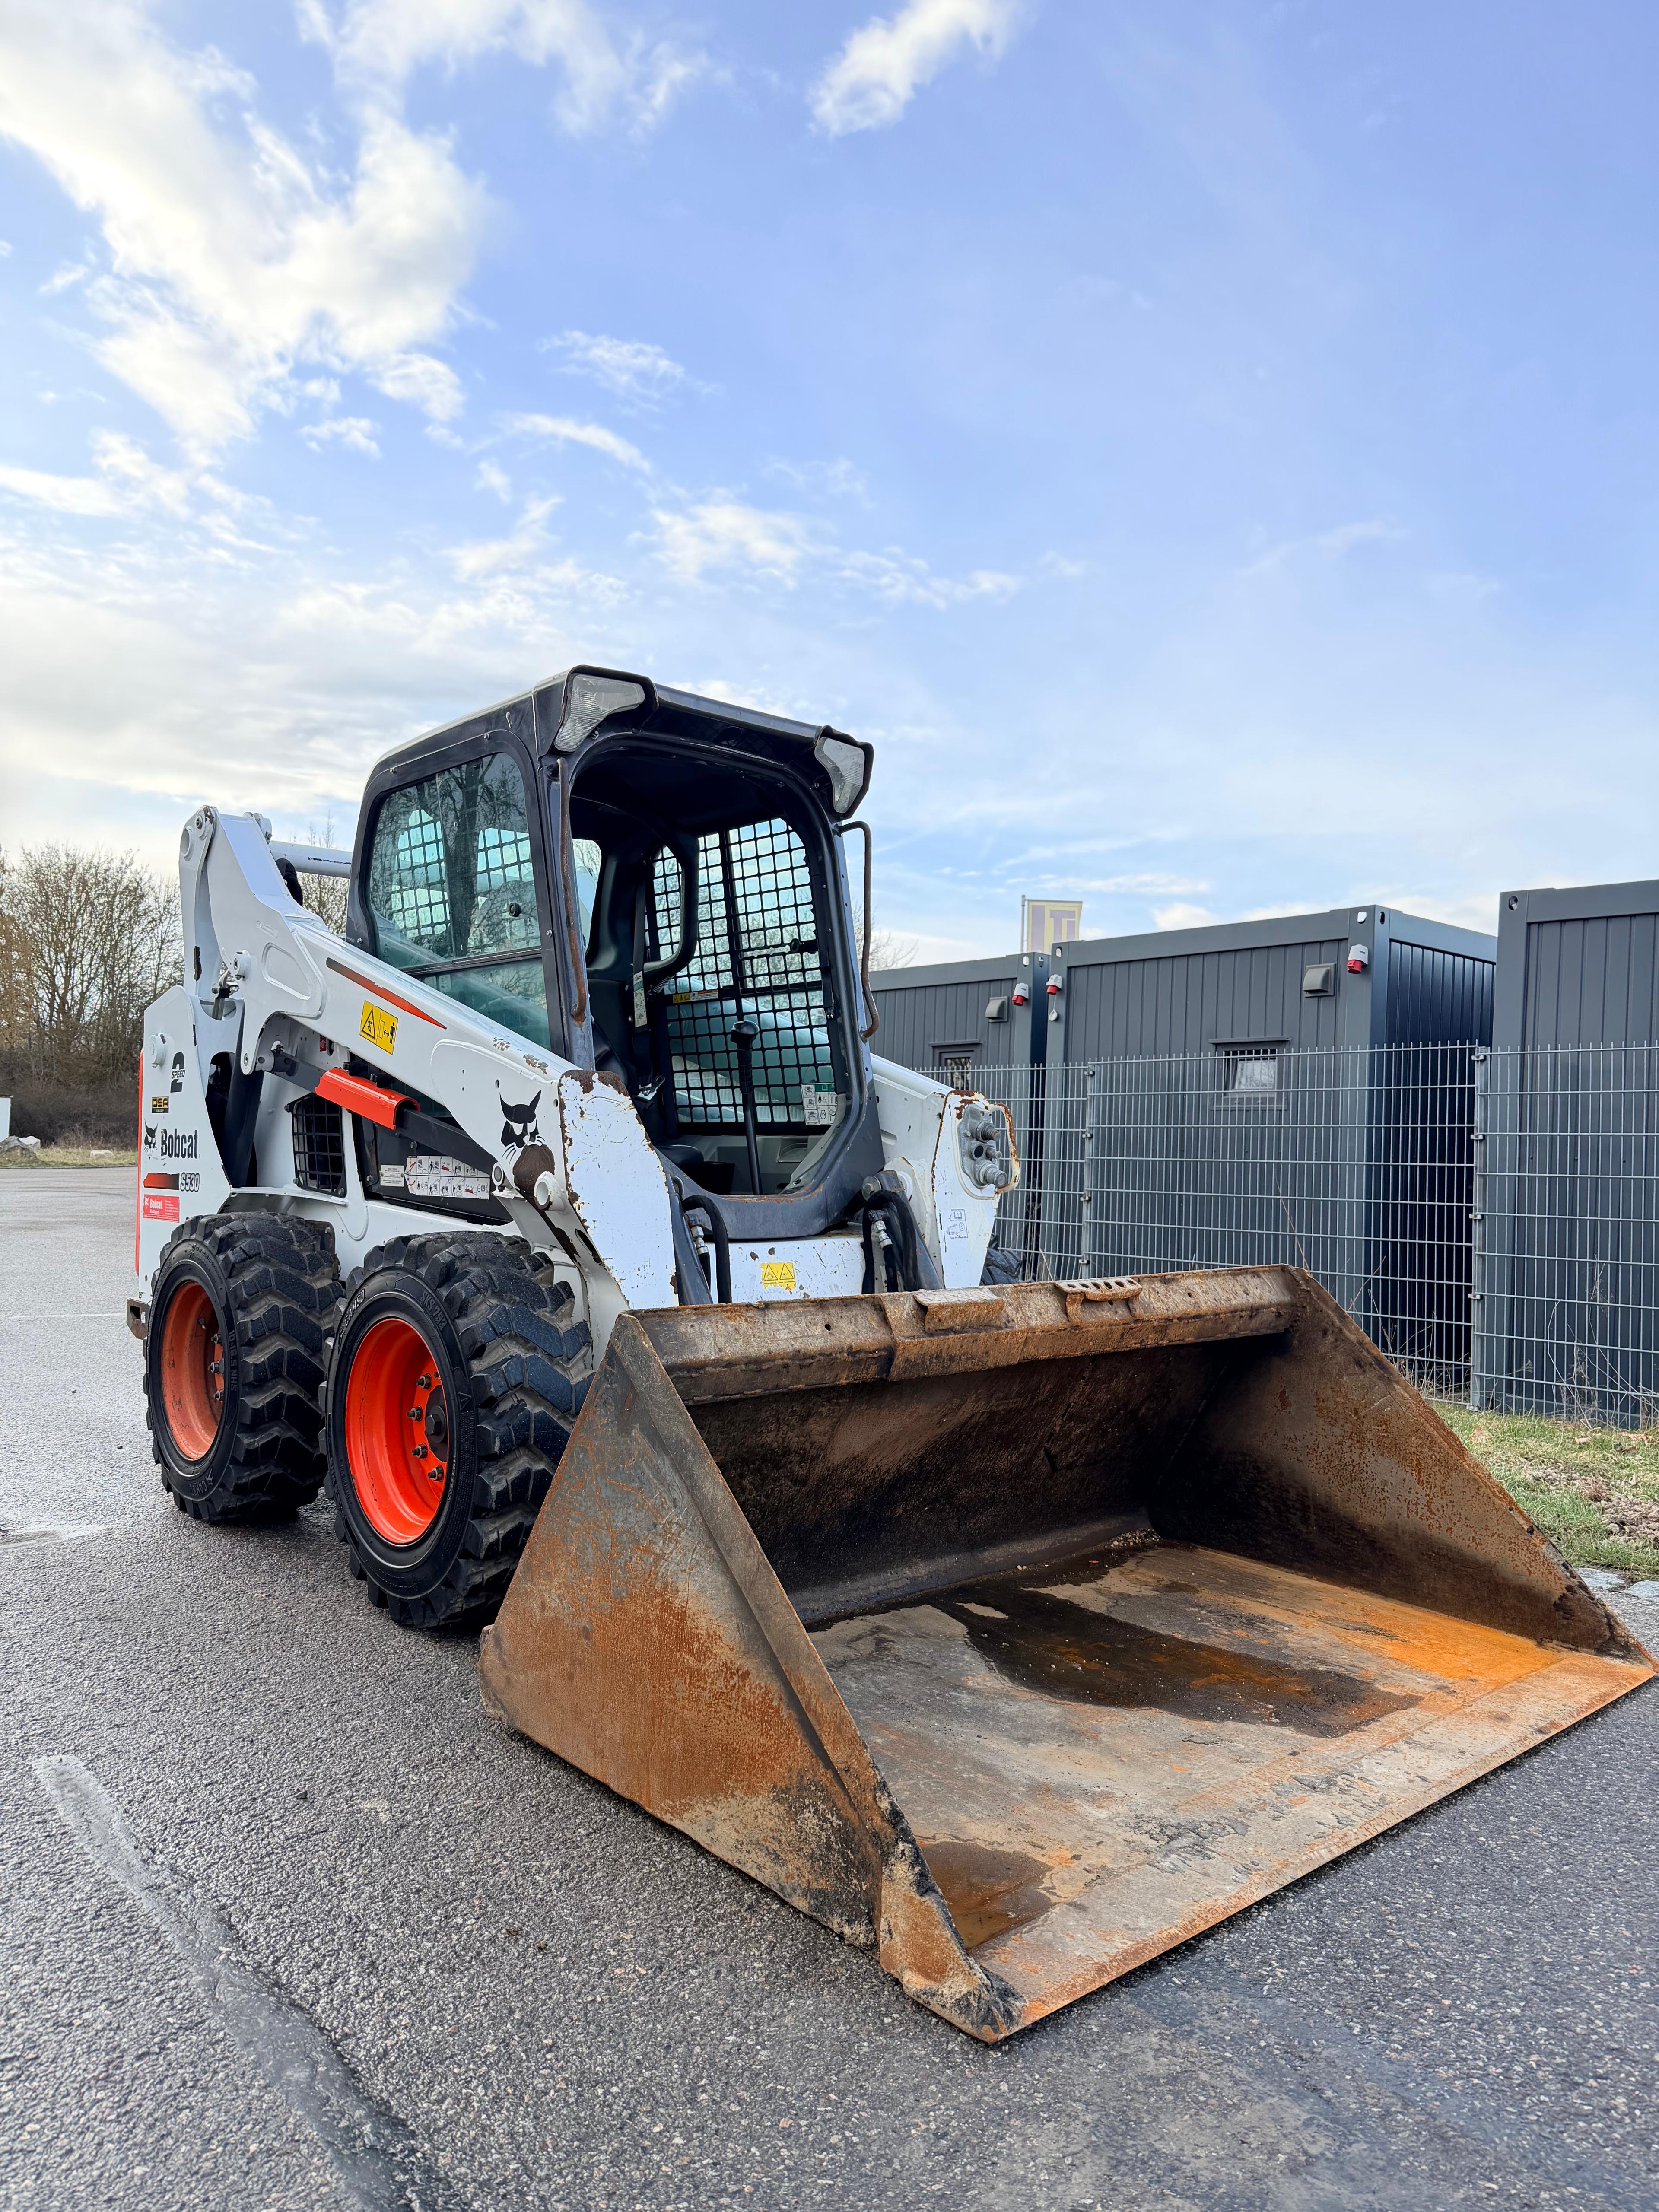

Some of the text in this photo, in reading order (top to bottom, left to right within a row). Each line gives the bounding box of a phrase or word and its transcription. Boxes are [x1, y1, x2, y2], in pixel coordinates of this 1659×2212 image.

[170, 1052, 184, 1093] 2
[172, 1070, 185, 1079] SPEED
[161, 1128, 198, 1159] Bobcat
[180, 1172, 200, 1192] S530
